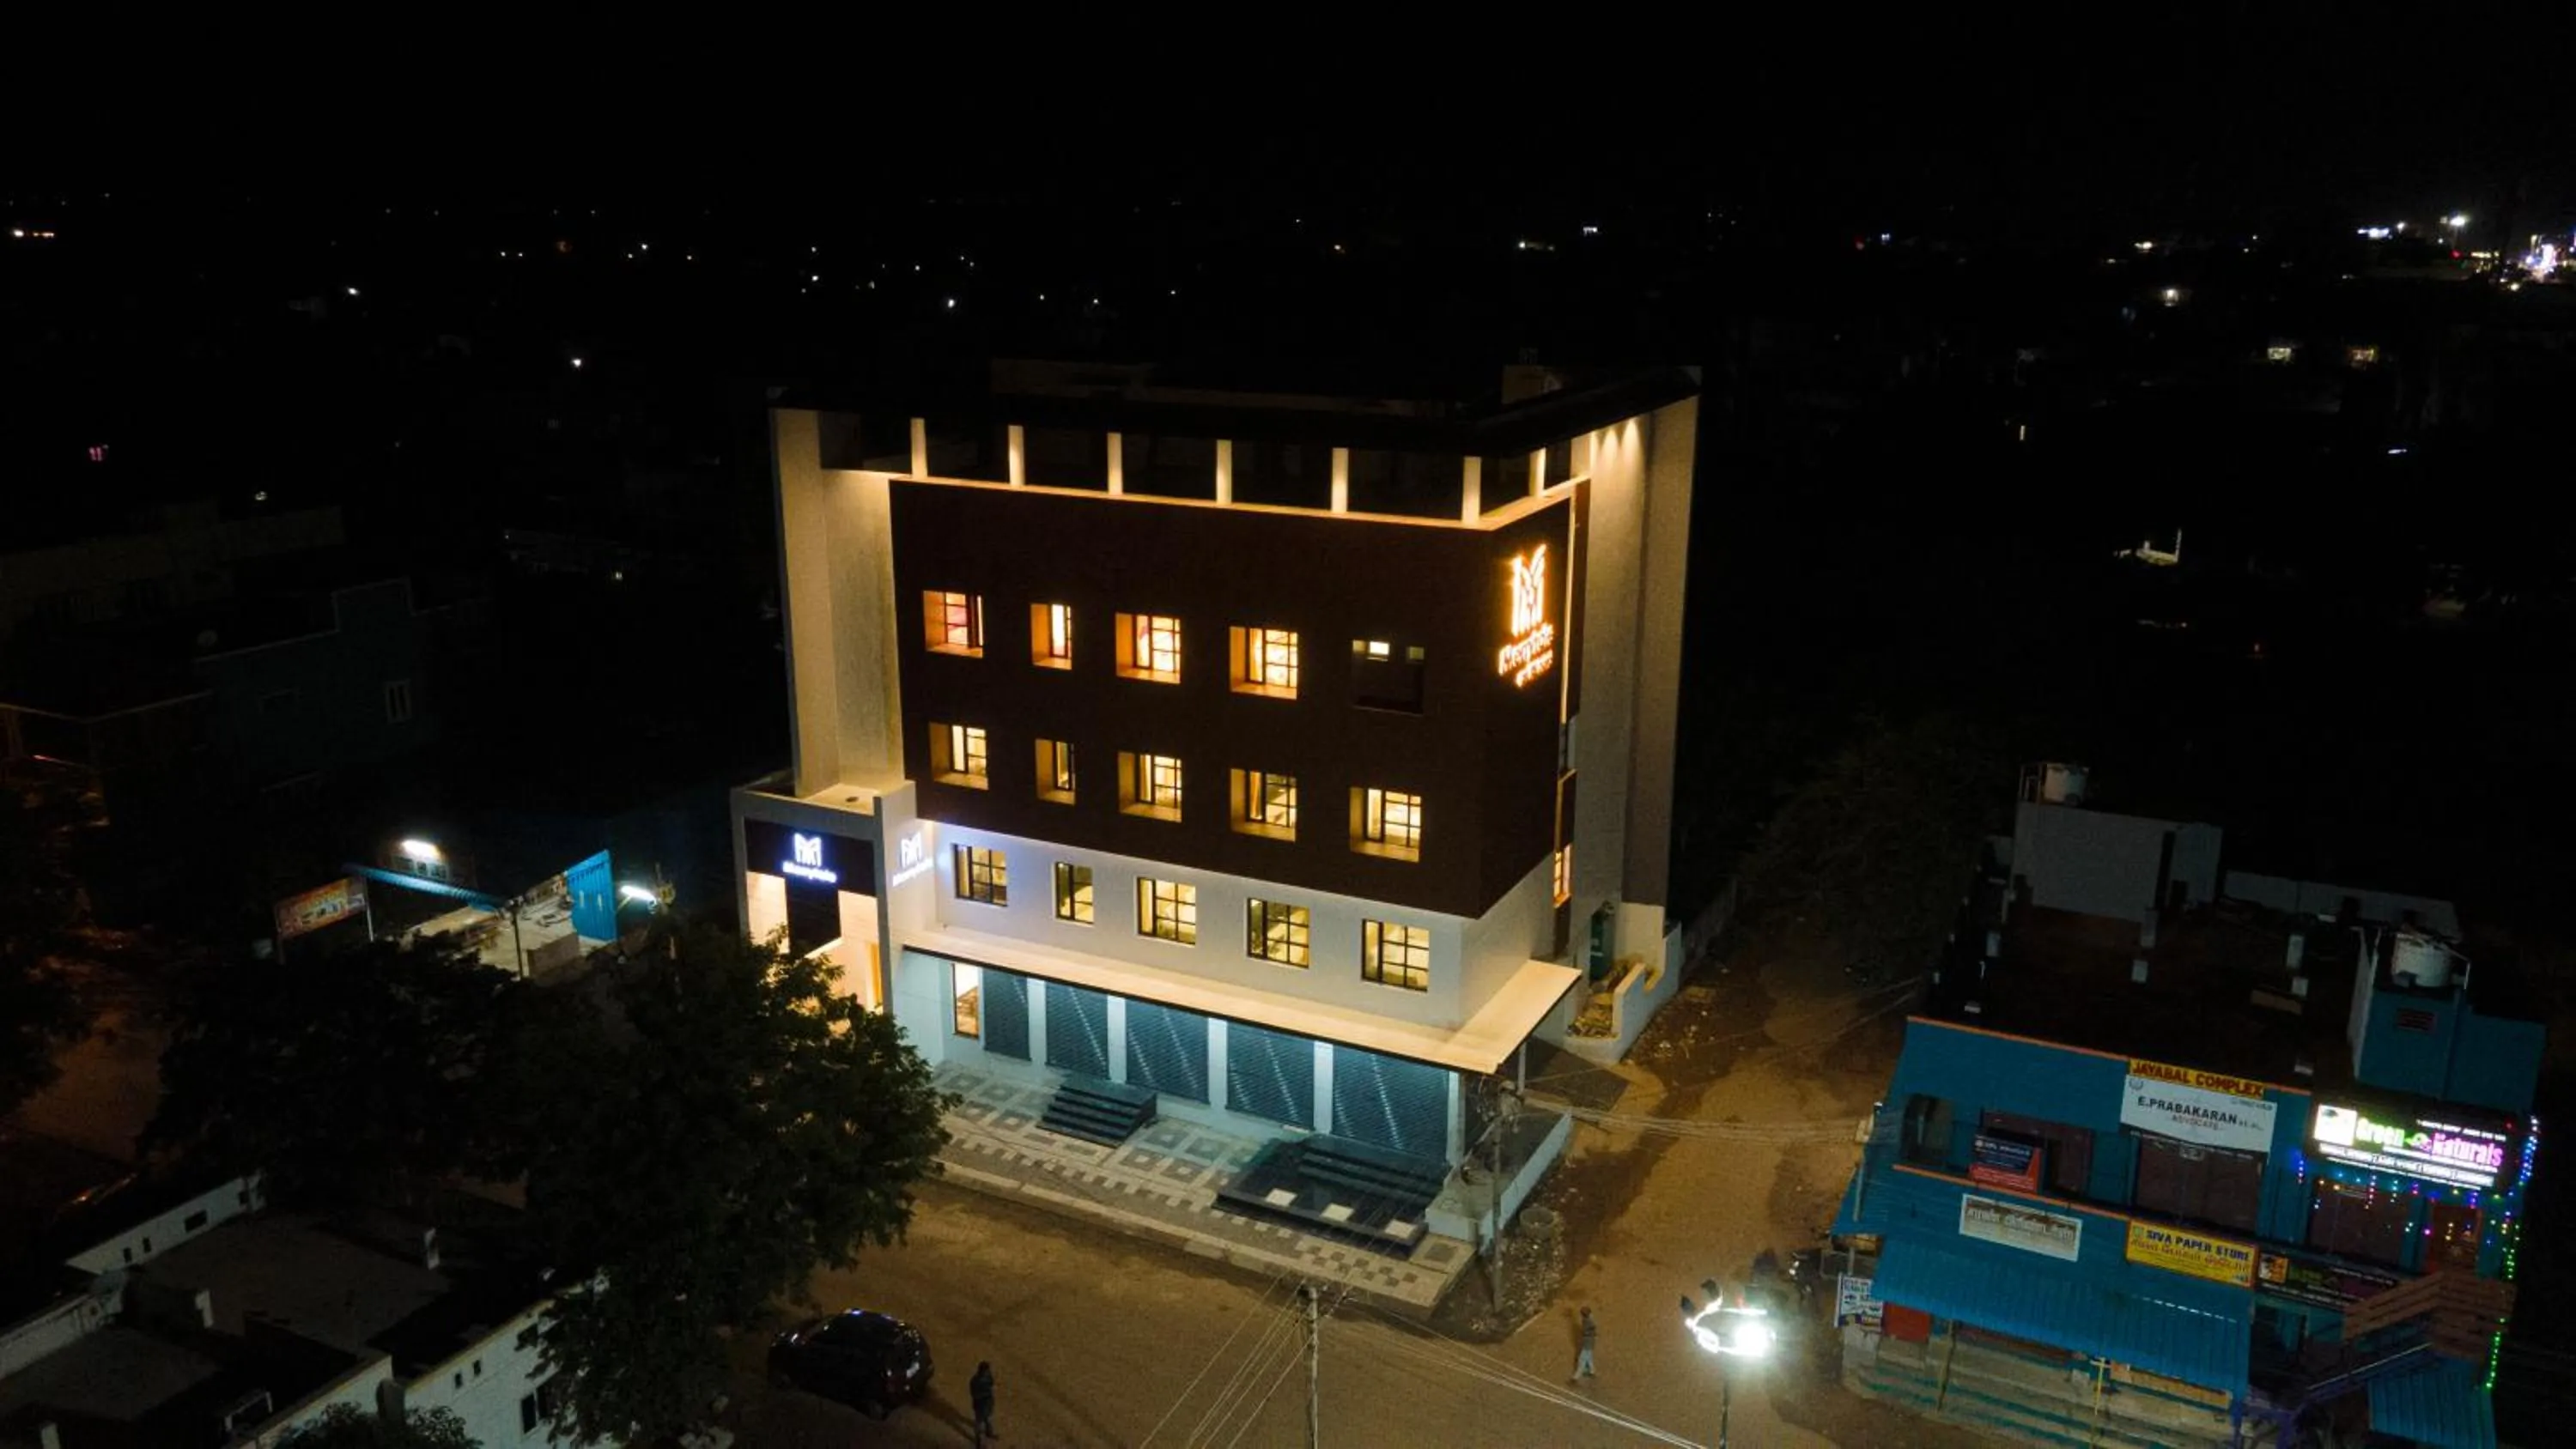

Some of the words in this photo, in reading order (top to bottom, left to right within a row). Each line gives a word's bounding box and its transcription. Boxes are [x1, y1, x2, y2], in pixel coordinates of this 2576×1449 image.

[2133, 1062, 2190, 1083] JAYABAL
[2196, 1073, 2263, 1097] COMPLEX
[2137, 1096, 2238, 1124] E.PRABAKARAN
[2432, 1131, 2504, 1167] Naturals
[2147, 1229, 2172, 1245] SIVA
[2175, 1236, 2213, 1253] PAPER
[2216, 1245, 2250, 1262] STORE
